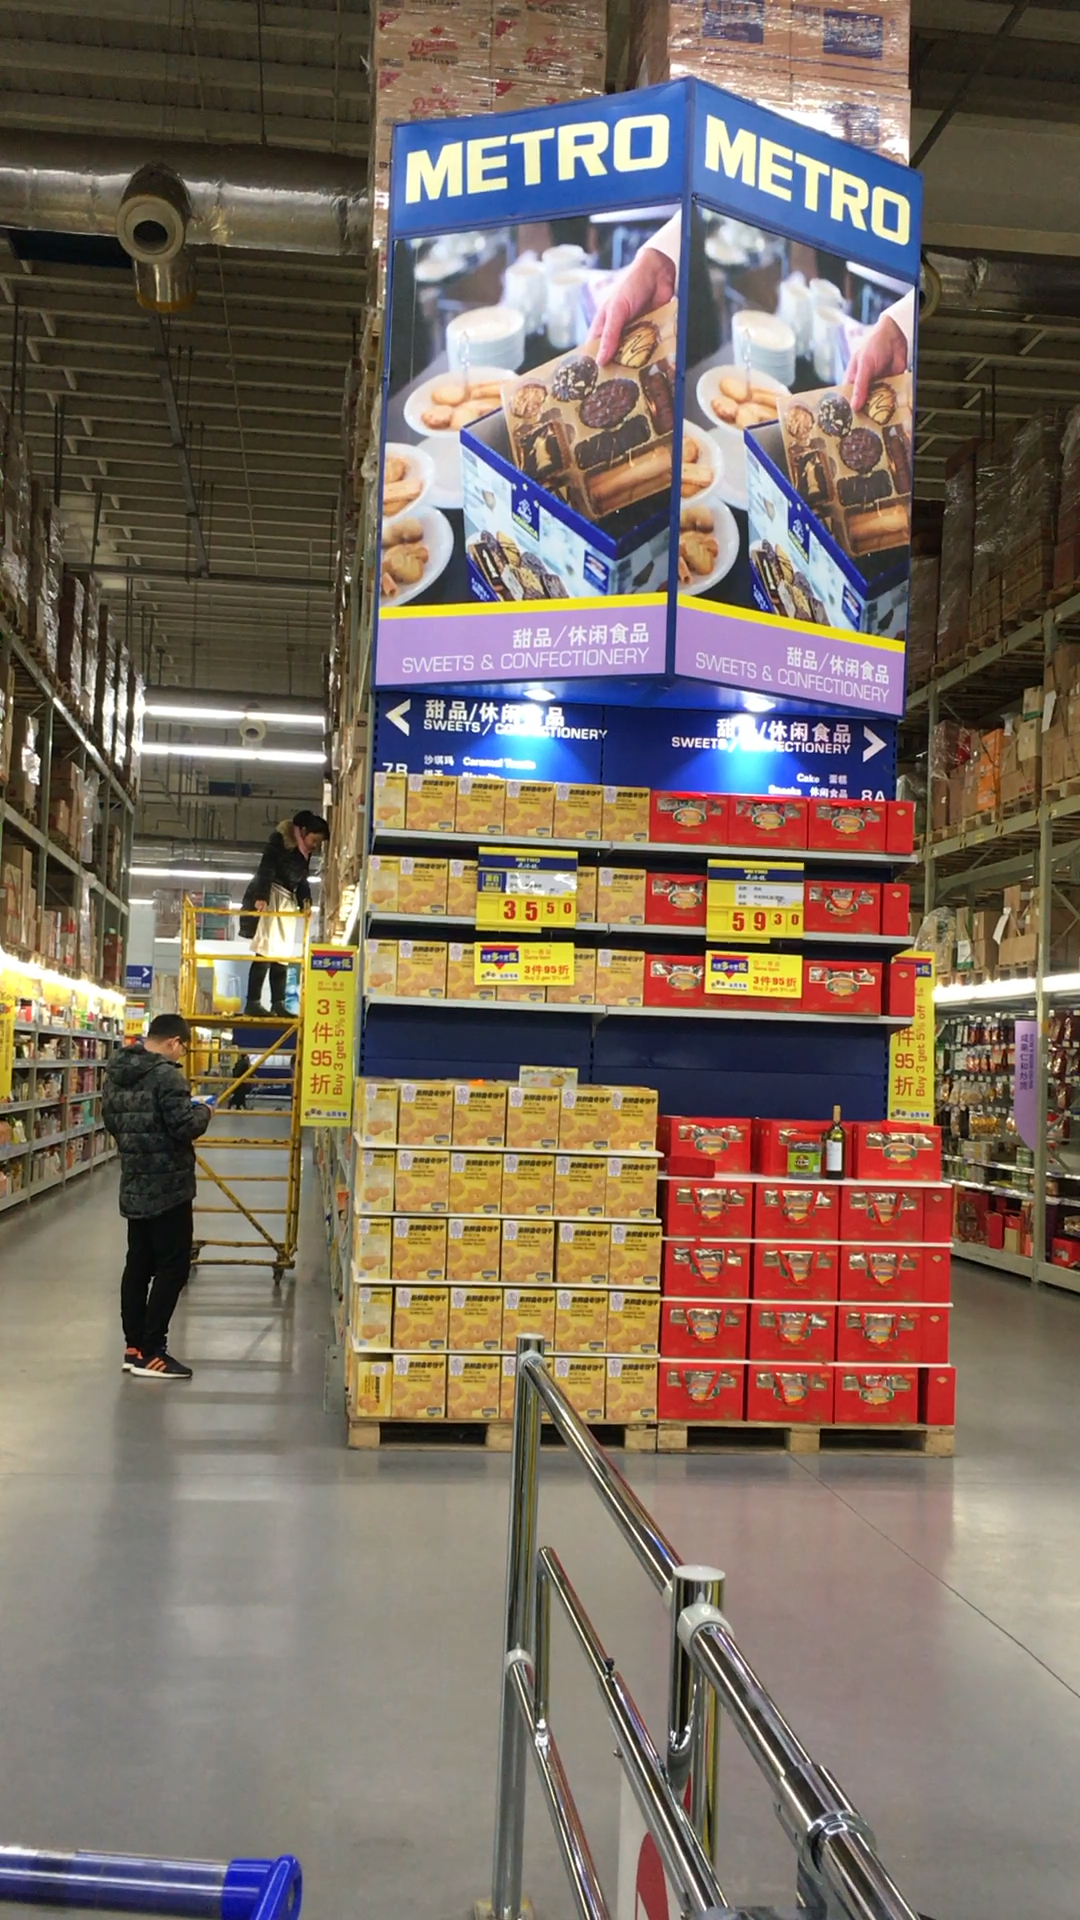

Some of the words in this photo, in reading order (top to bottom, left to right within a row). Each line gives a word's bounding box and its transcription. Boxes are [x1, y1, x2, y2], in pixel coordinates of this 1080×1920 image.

[405, 114, 670, 205] METRO
[704, 114, 911, 246] METRO
[513, 622, 650, 649] 甜品/休闲食品
[402, 656, 474, 674] SWEETS
[480, 654, 495, 671] &
[500, 647, 650, 670] CONFECTIONERY
[787, 646, 890, 685] 甜品/休闲食品
[695, 651, 757, 679] SWEETS
[762, 665, 773, 682] &
[777, 668, 890, 704] CONFECTIONERY
[425, 699, 565, 728] 甜品/休闲品
[717, 717, 851, 744] 甜/休闲食品
[796, 773, 820, 784] Cake
[335, 999, 346, 1015] off
[917, 1004, 926, 1019] off
[335, 1040, 347, 1060] get
[917, 1042, 927, 1062] get
[334, 1064, 344, 1073] 3
[916, 1064, 925, 1074] 3
[333, 1072, 347, 1096] Buy
[916, 1074, 928, 1098] Buy
